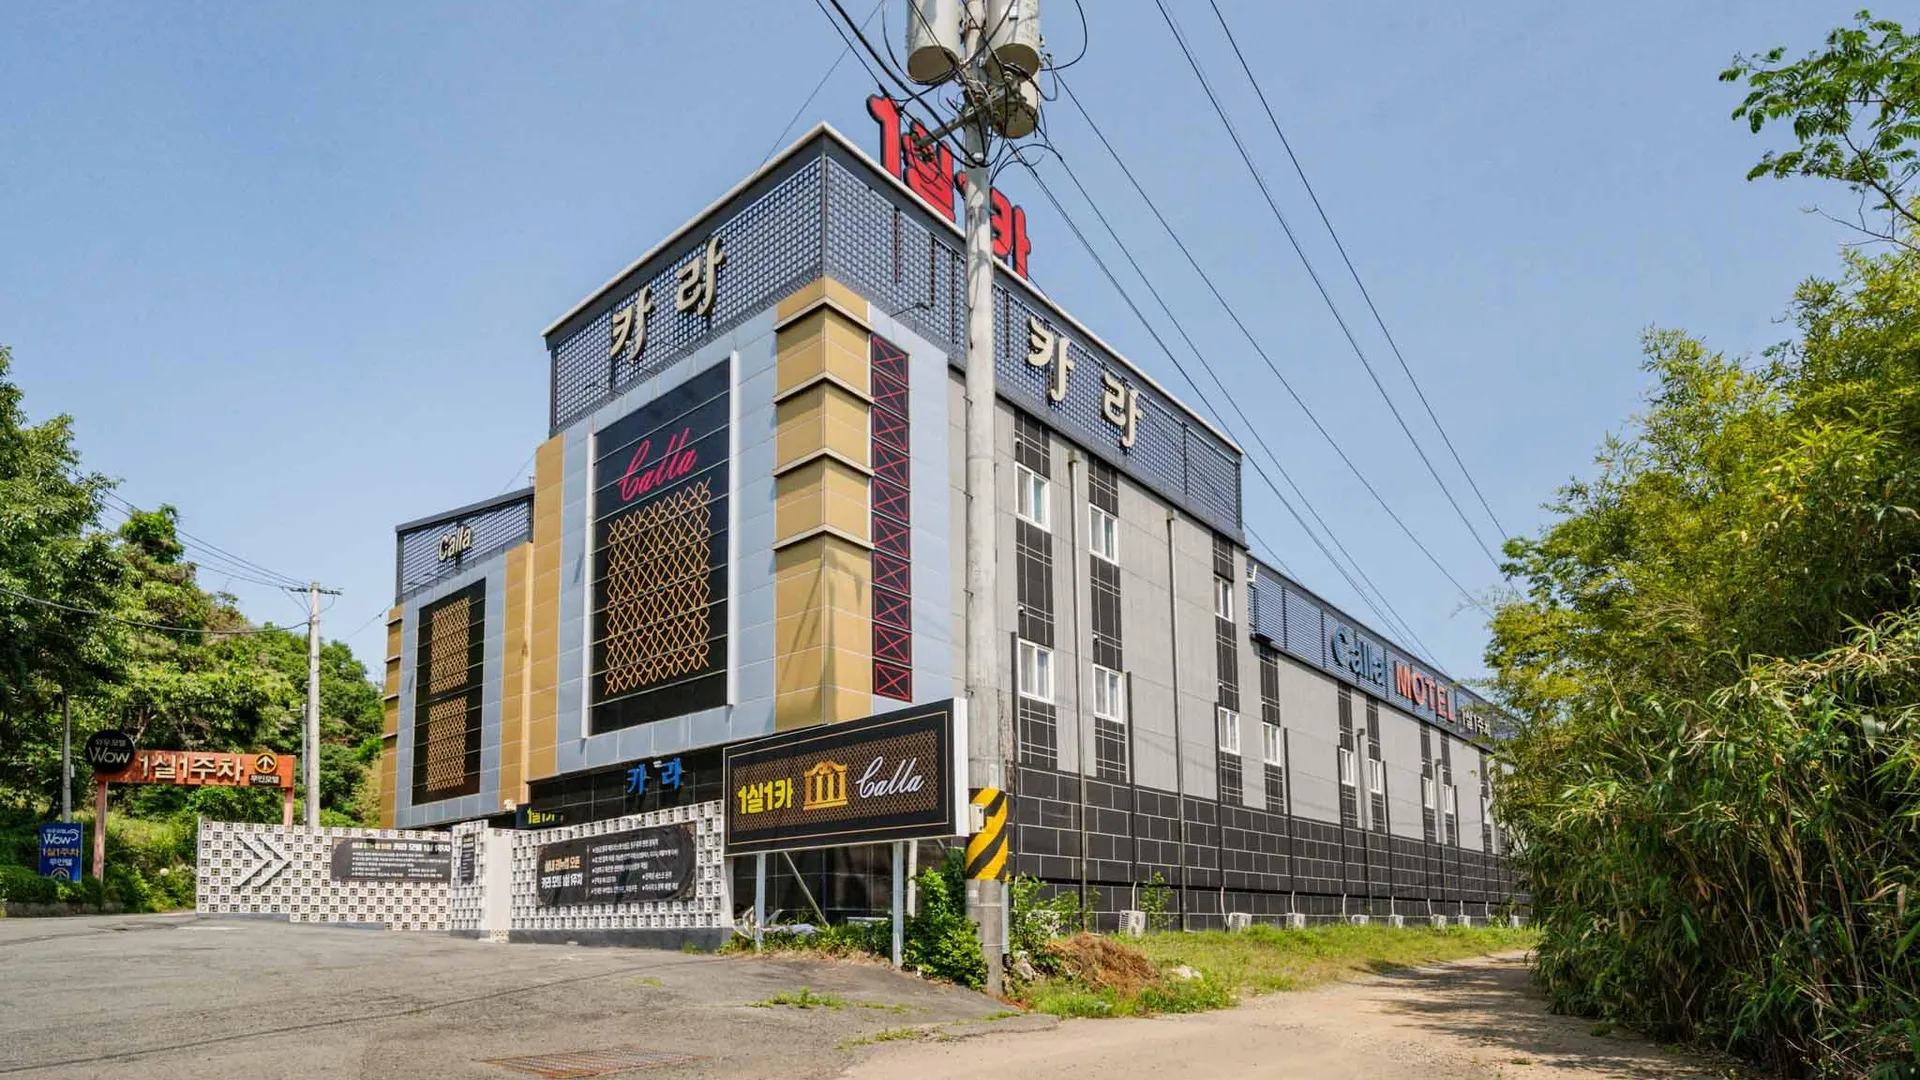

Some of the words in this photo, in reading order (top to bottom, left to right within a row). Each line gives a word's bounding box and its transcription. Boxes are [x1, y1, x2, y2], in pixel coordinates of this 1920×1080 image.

[866, 95, 1031, 280] 1실카
[617, 427, 698, 502] Calla
[1395, 660, 1457, 722] MOTEL
[138, 753, 244, 781] 1실1주차
[855, 756, 925, 799] Calla
[737, 777, 794, 815] 1실1카
